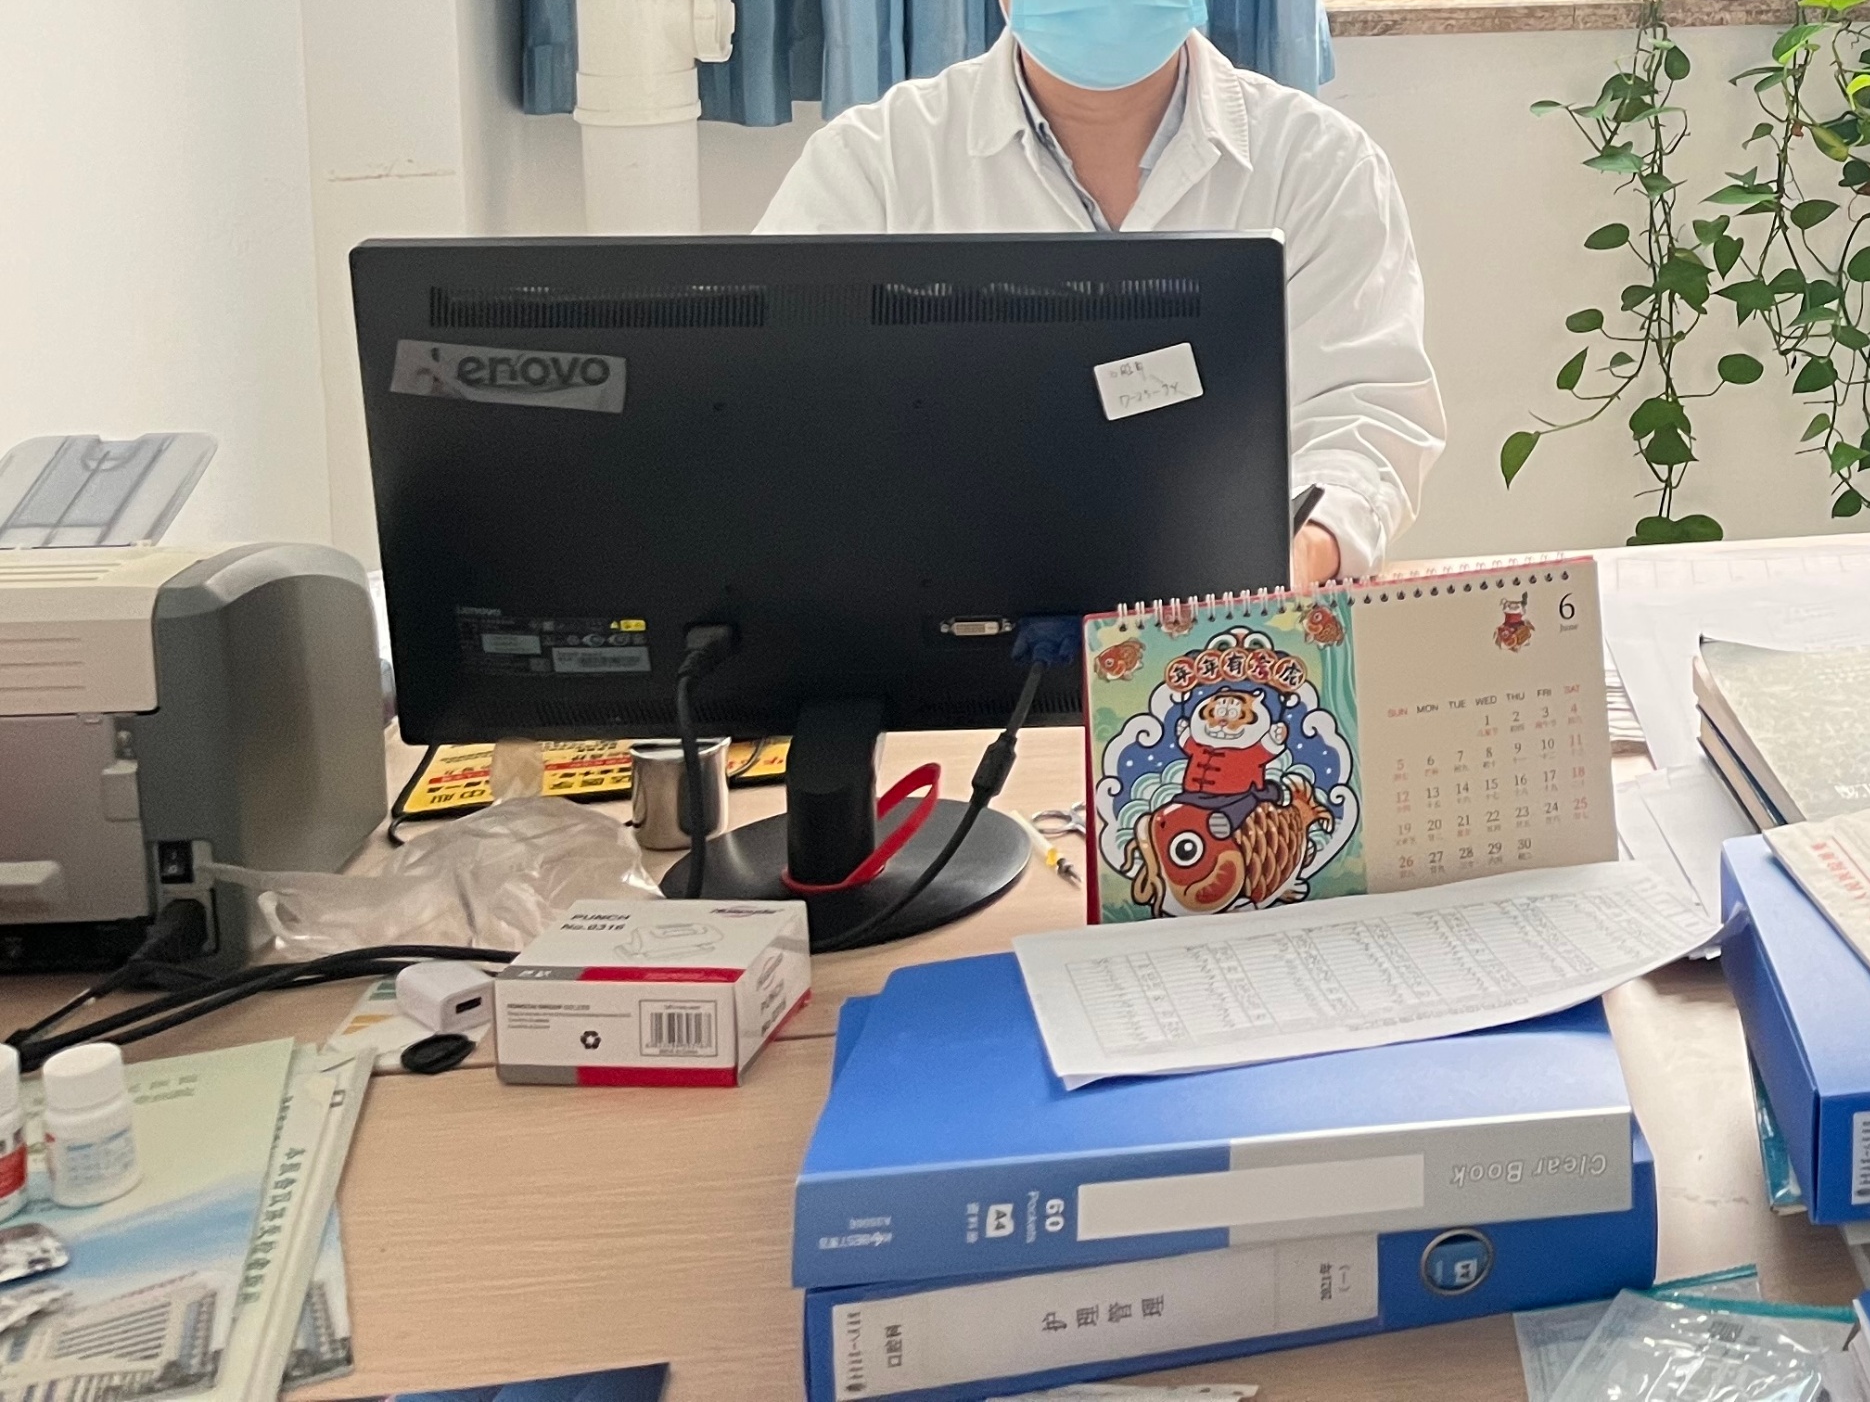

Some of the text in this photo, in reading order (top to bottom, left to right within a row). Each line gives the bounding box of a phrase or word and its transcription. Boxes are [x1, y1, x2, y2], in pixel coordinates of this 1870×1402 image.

[430, 348, 611, 387] enovo
[1559, 592, 1575, 620] 6
[1388, 684, 1580, 717] SUN MON TUE WED THU FRI SAT
[1484, 703, 1577, 726] 1 2 3 4
[1397, 734, 1582, 771] 5 6 7 8 9 10 11
[1396, 766, 1586, 804] 12 13 14 15 16 17 18
[1399, 796, 1588, 835] 19 20 21 22 23 24 25
[1400, 855, 1414, 869] 26
[1428, 850, 1444, 864] 27
[1458, 846, 1474, 860] 28
[1488, 842, 1502, 855] 29
[1517, 838, 1532, 850] 30
[1452, 1154, 1607, 1187] Clear Book
[995, 1209, 1007, 1231] A4
[1045, 1198, 1065, 1232] 60
[1042, 1294, 1164, 1332] 护理管理
[884, 1324, 903, 1368] 口腔科
